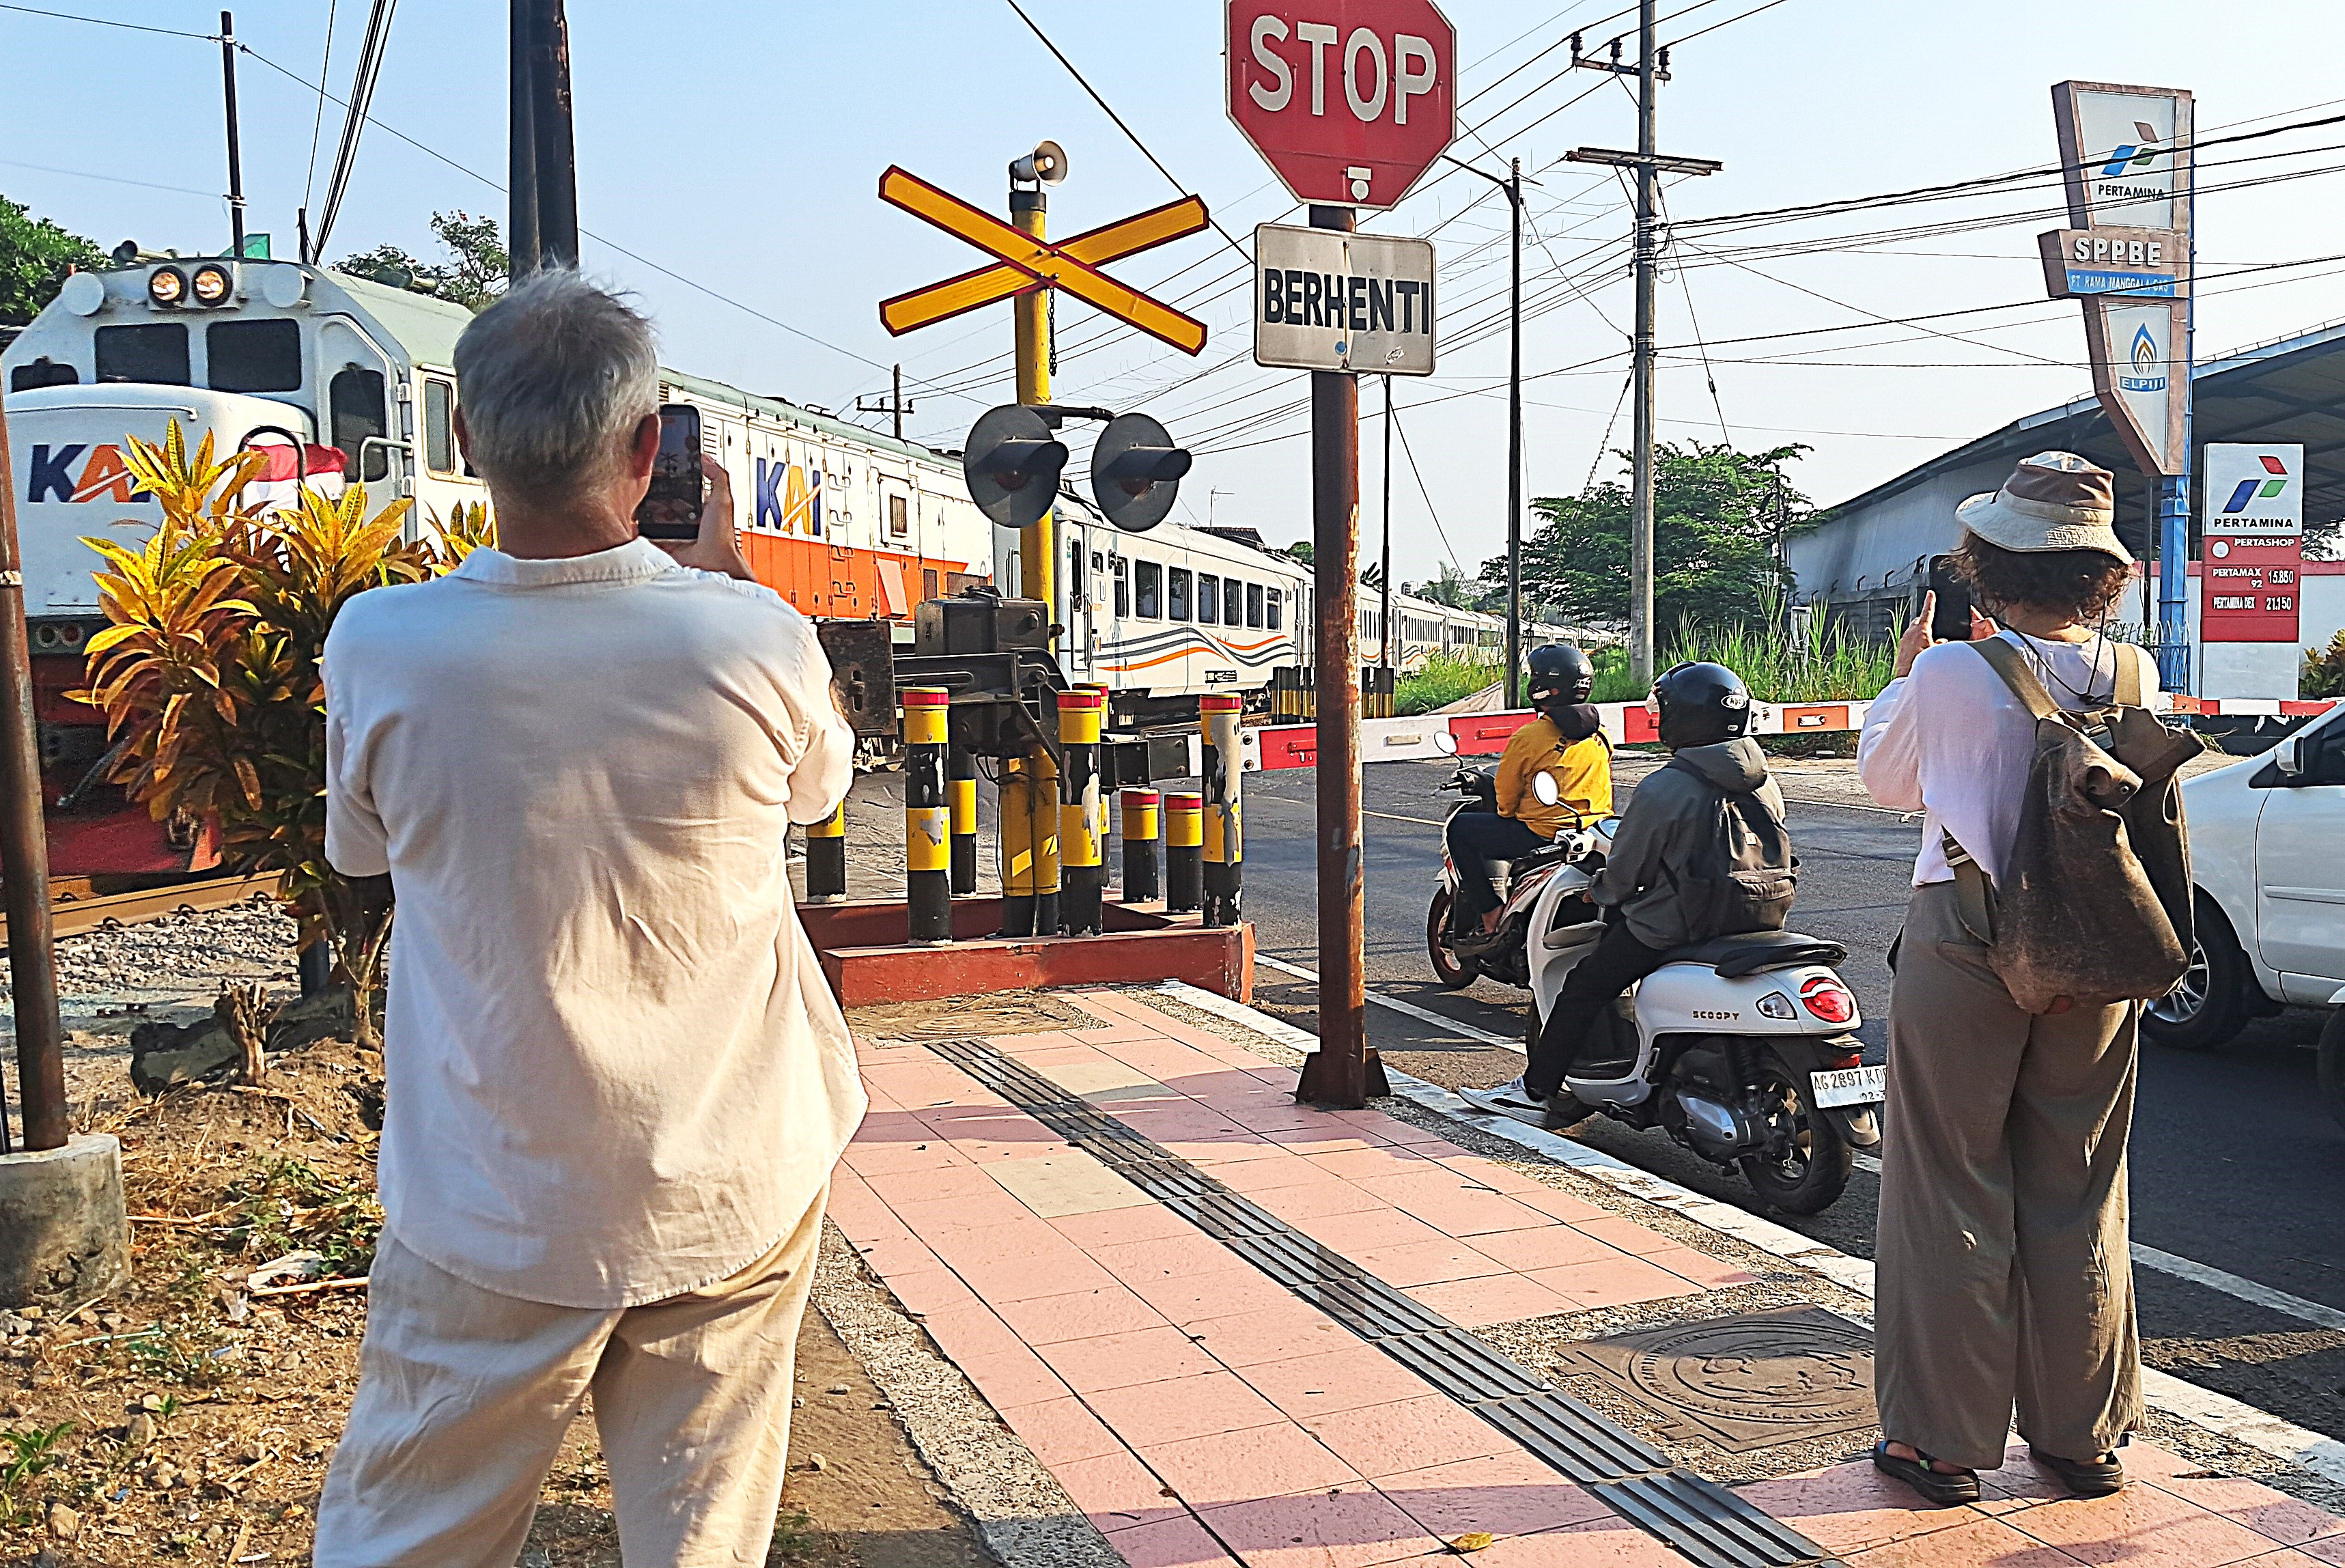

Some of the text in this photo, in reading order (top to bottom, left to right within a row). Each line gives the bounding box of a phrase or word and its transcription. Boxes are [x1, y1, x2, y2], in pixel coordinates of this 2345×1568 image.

[1249, 15, 1436, 125] STOP
[2098, 184, 2164, 199] PERTAMINA
[2075, 237, 2162, 267] SPPBE
[2071, 275, 2080, 287] PT
[2085, 275, 2105, 289] RAMA
[1264, 268, 1429, 334] BERHENTI
[2122, 378, 2163, 390] ELPIJI
[756, 458, 821, 536] KAI
[2214, 518, 2294, 528] PERTAMINA
[2234, 538, 2295, 547] PERTASHOP
[2213, 568, 2262, 577] PERTAMAX
[2251, 579, 2263, 588] 92
[2213, 597, 2244, 609] PERTAMINA
[2244, 597, 2256, 609] DEX
[1692, 1010, 1739, 1020] SCOOPY
[1814, 1075, 1829, 1091] AG
[1831, 1070, 1862, 1089] 2897
